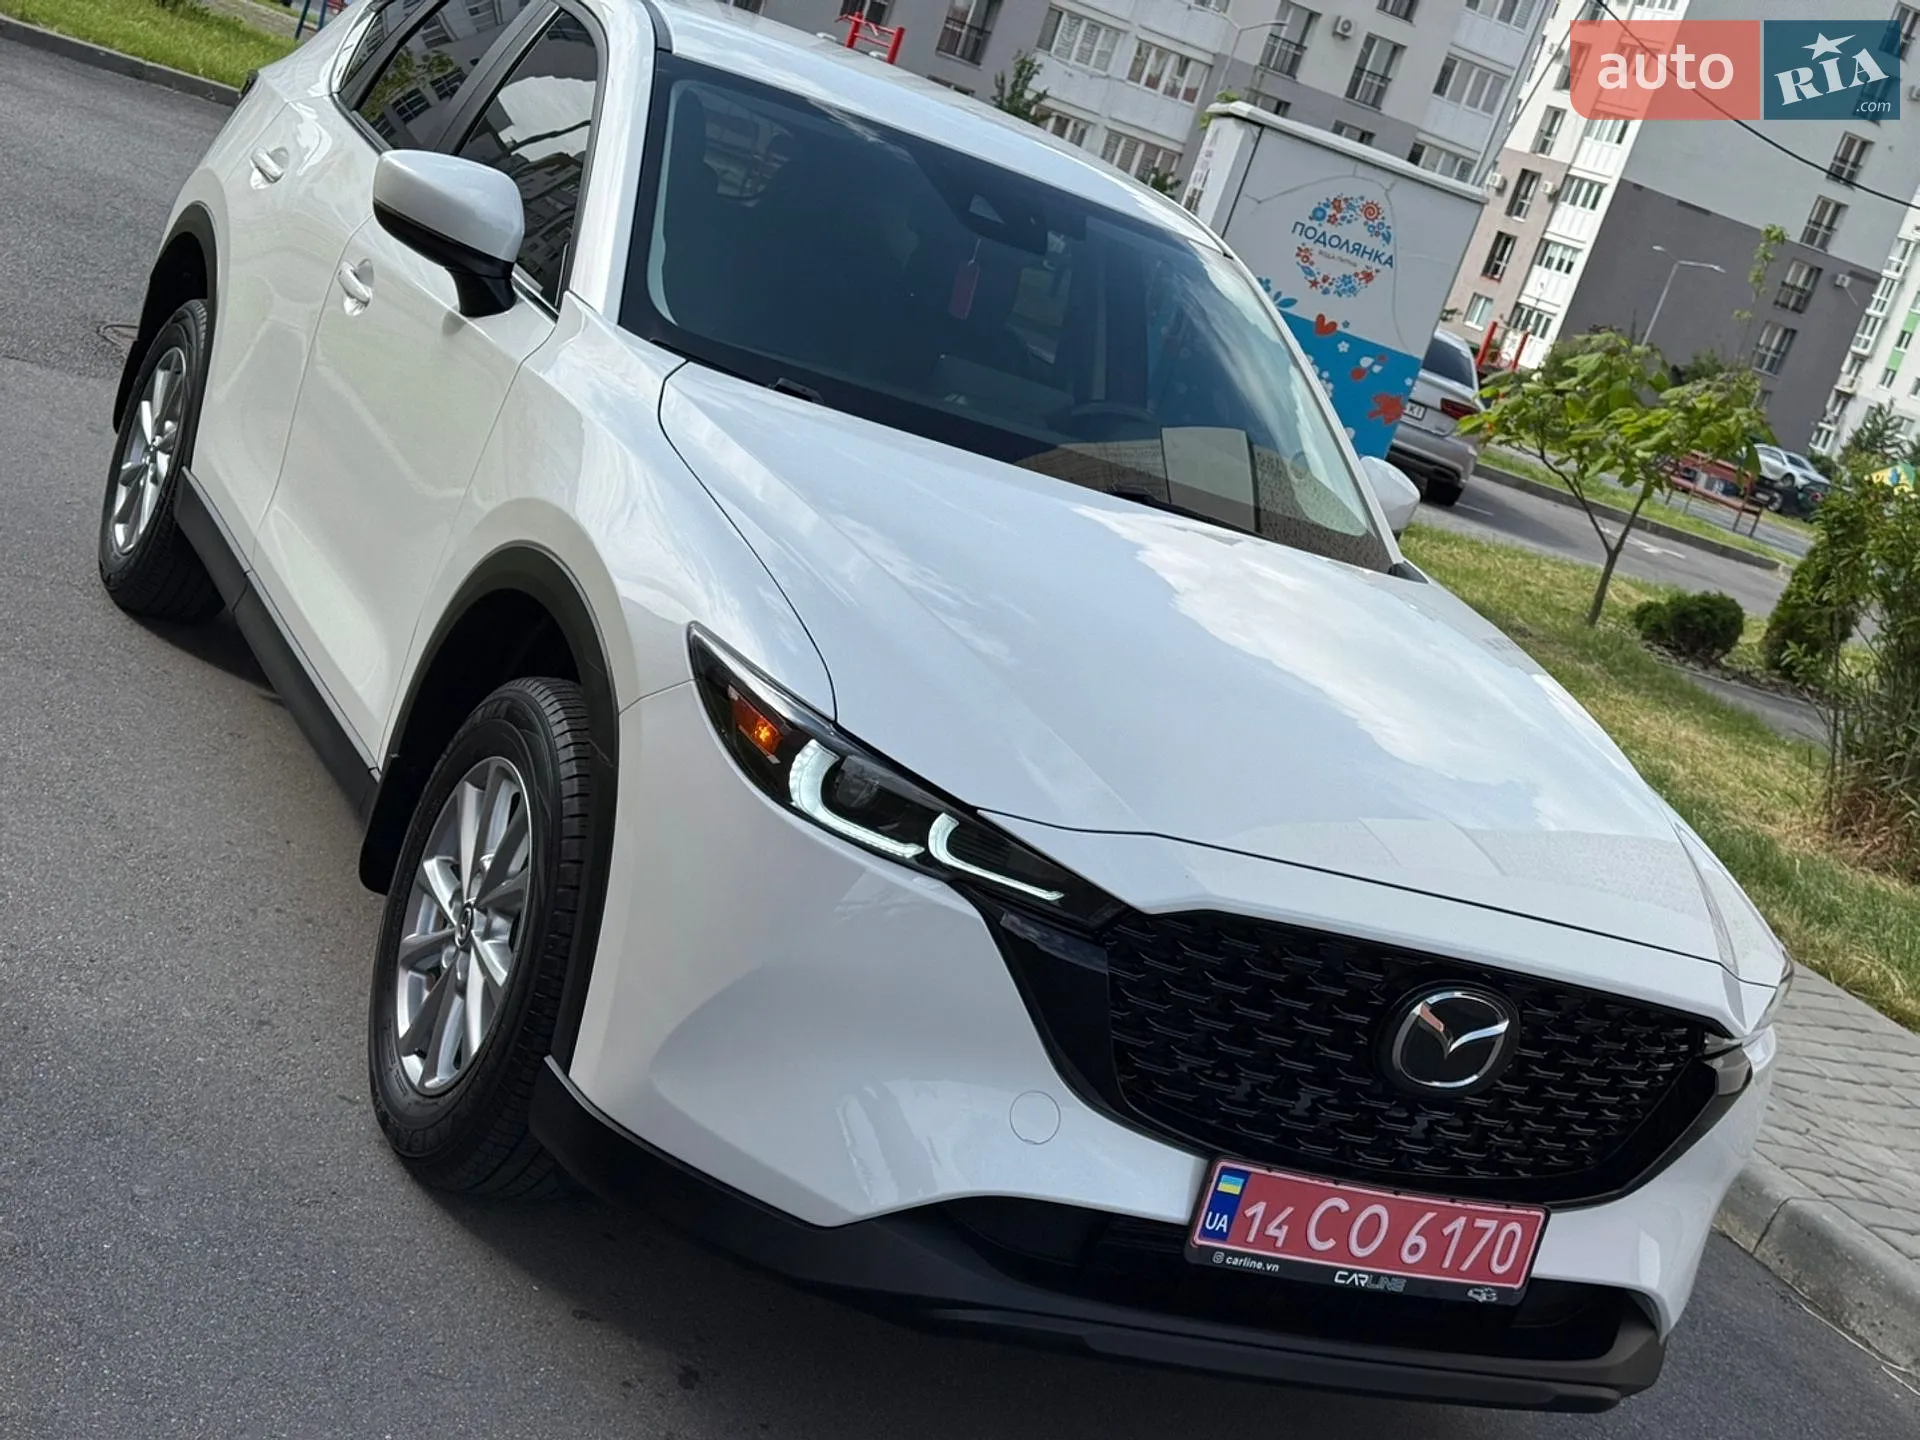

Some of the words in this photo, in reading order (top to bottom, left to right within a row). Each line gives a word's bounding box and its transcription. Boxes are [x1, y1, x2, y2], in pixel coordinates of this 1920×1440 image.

[1292, 221, 1394, 269] ПОДОЛЯНКА
[1205, 1211, 1229, 1233] UA
[1244, 1201, 1295, 1248] 14
[1306, 1197, 1389, 1259] CO
[1400, 1212, 1522, 1274] 6170
[1225, 1256, 1279, 1273] carline.vn
